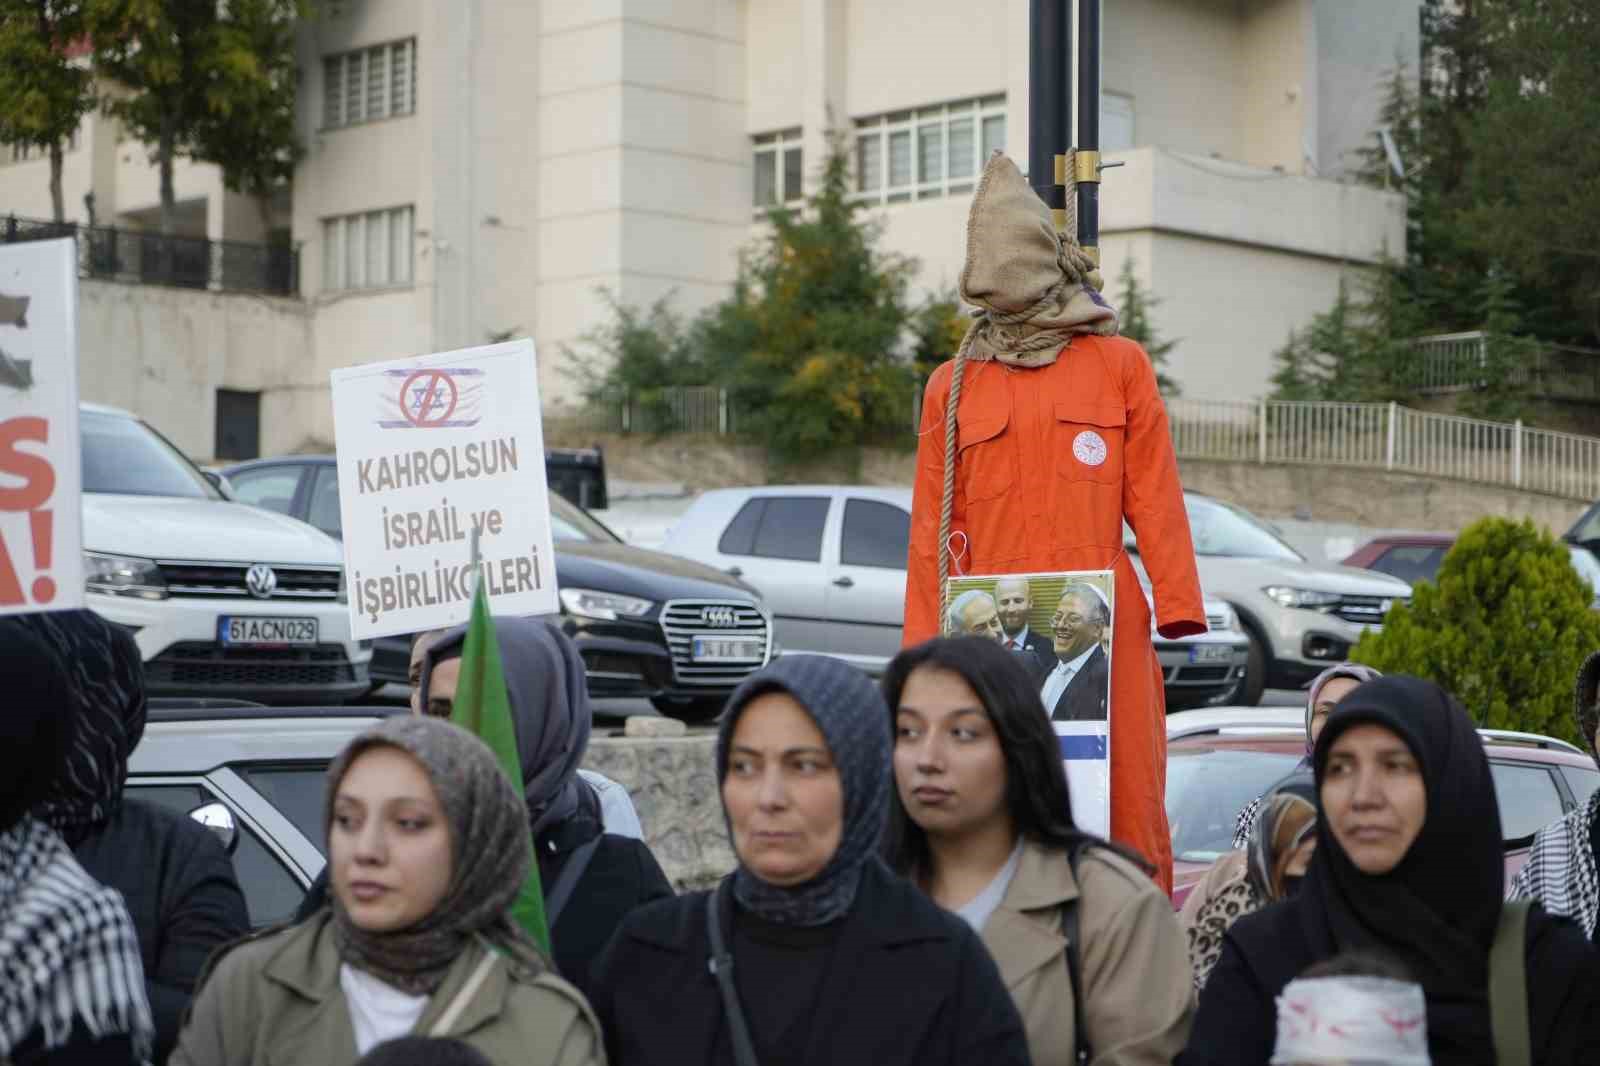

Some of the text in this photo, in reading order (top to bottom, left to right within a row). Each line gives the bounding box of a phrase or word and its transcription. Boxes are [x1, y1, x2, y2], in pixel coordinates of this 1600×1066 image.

[358, 437, 518, 494] KAHROLSUN
[383, 497, 503, 550] İSRAİL ve
